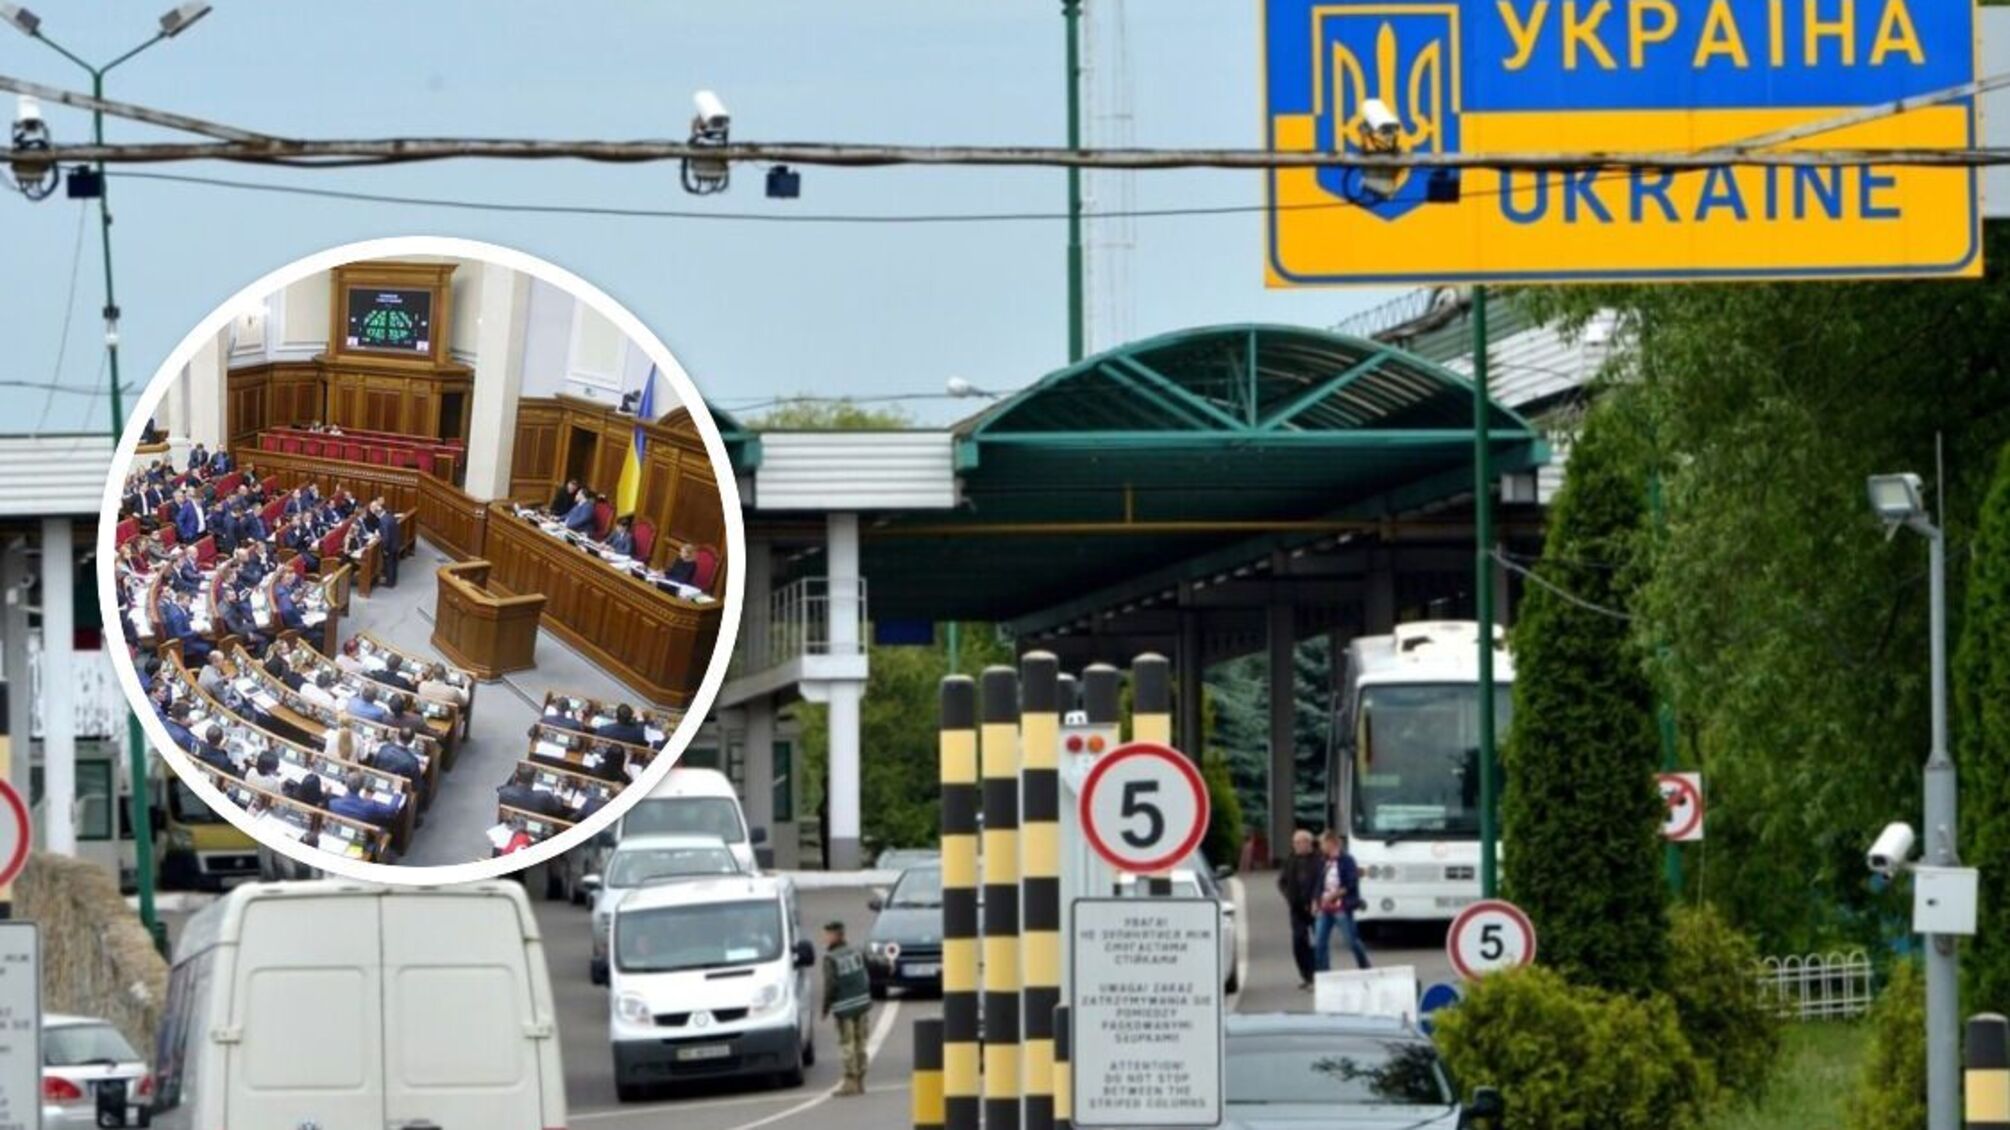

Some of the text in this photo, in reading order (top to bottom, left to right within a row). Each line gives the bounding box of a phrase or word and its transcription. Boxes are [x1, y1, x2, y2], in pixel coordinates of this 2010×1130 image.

[1498, 163, 1902, 225] UKRAINE
[1120, 780, 1165, 849] 5
[1480, 924, 1503, 960] 5
[1103, 1073, 1190, 1084] DO NOT STOP
[1103, 1085, 1190, 1096] BETWEEN THE
